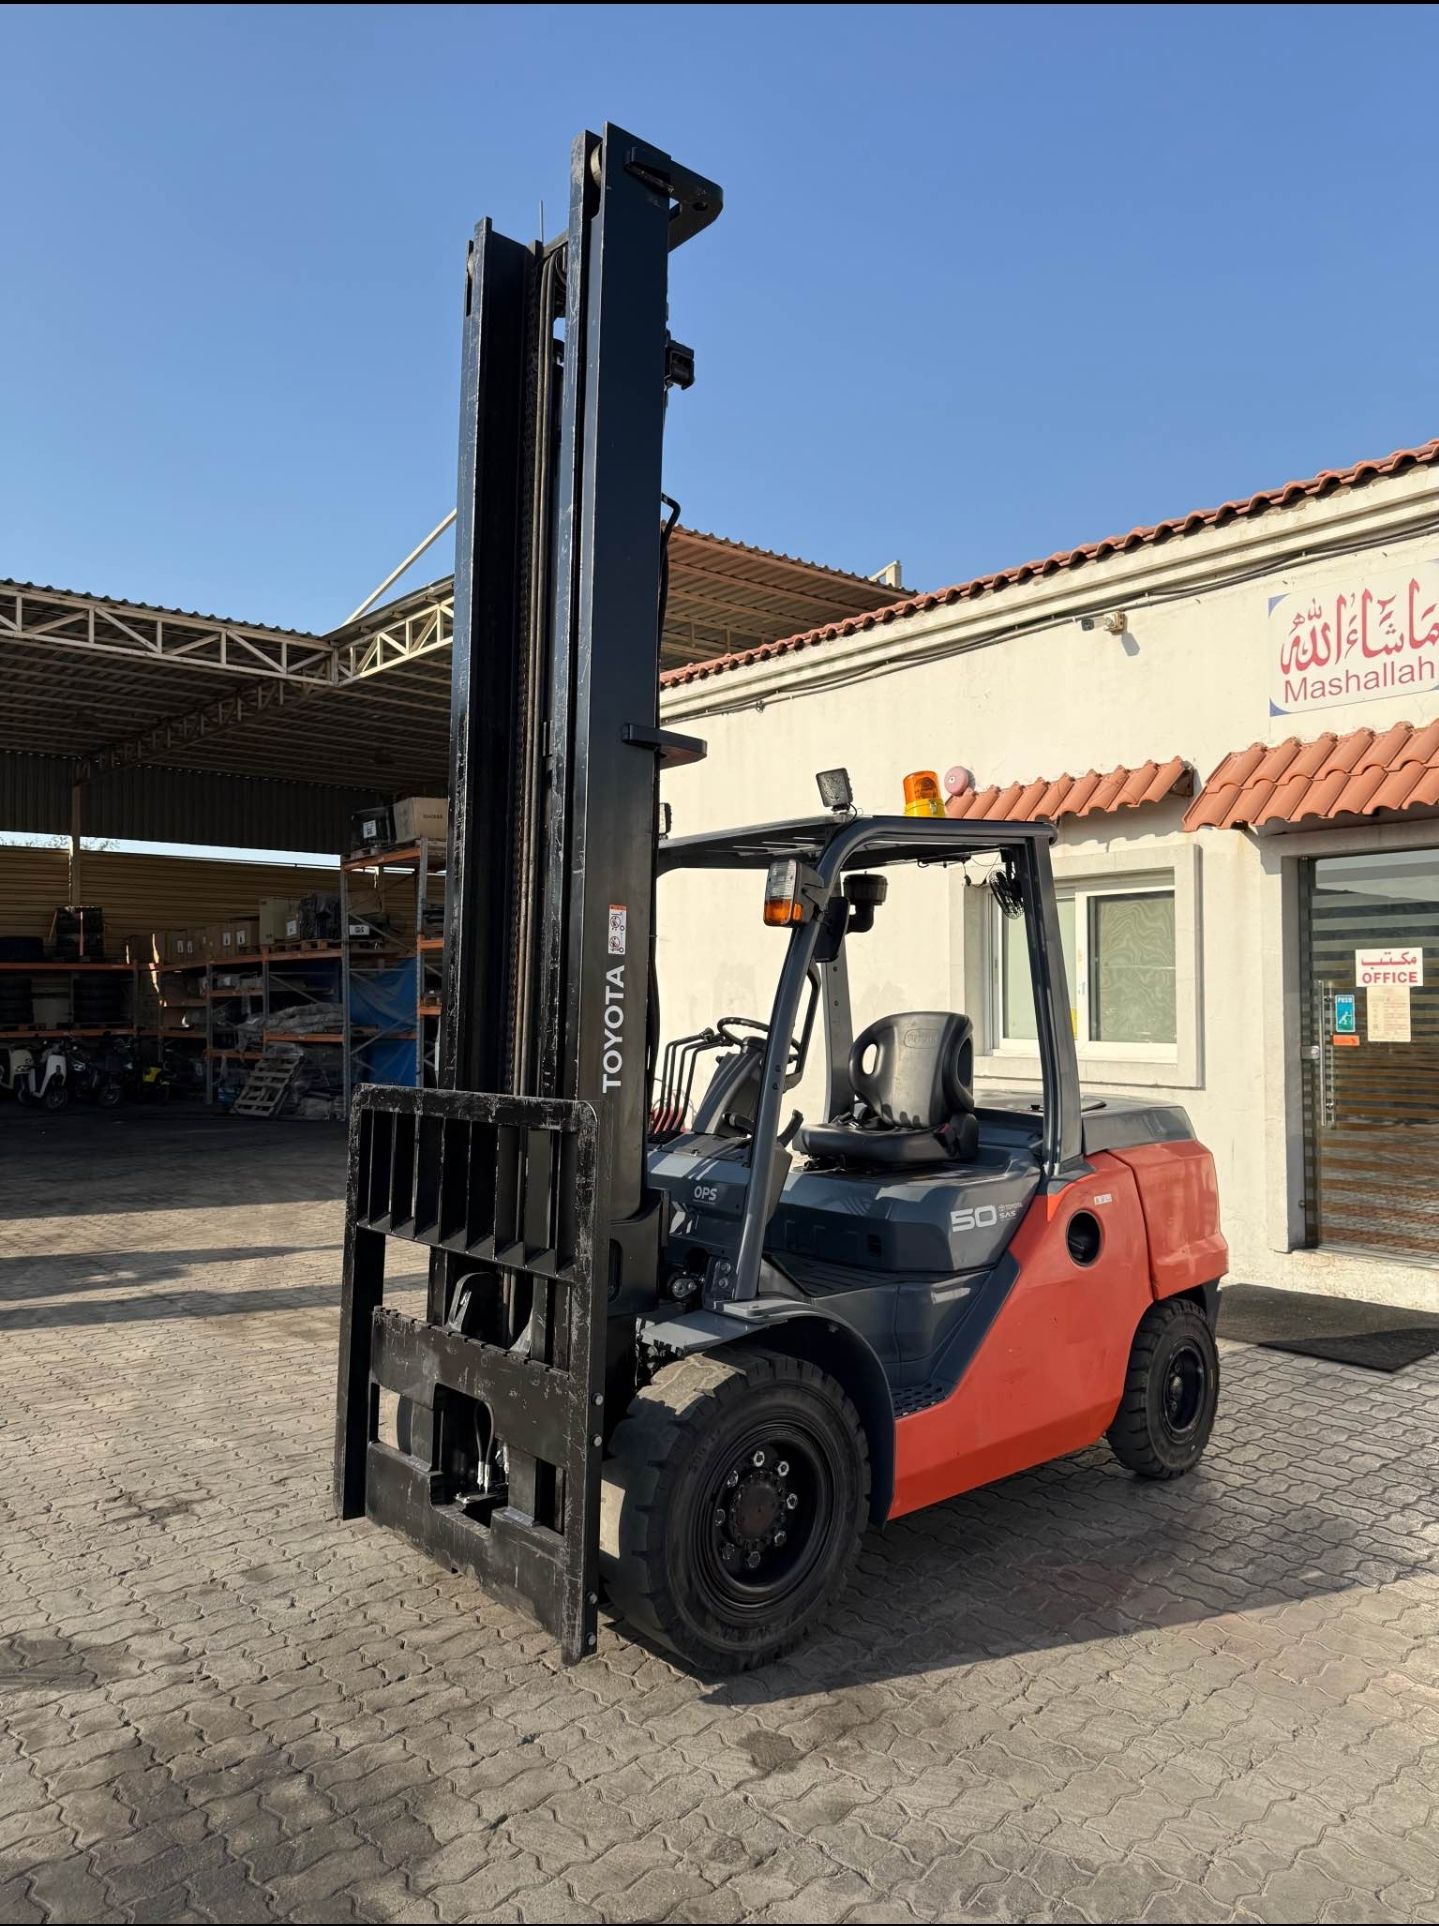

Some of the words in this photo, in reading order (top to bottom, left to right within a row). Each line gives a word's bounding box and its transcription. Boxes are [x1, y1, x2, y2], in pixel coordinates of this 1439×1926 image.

[1284, 656, 1435, 703] Mashallah
[1361, 951, 1417, 970] مكتب
[1362, 971, 1418, 984] OFFICE
[602, 964, 625, 1094] TOYOTA
[694, 1186, 718, 1201] OPS
[950, 1204, 998, 1232] 50
